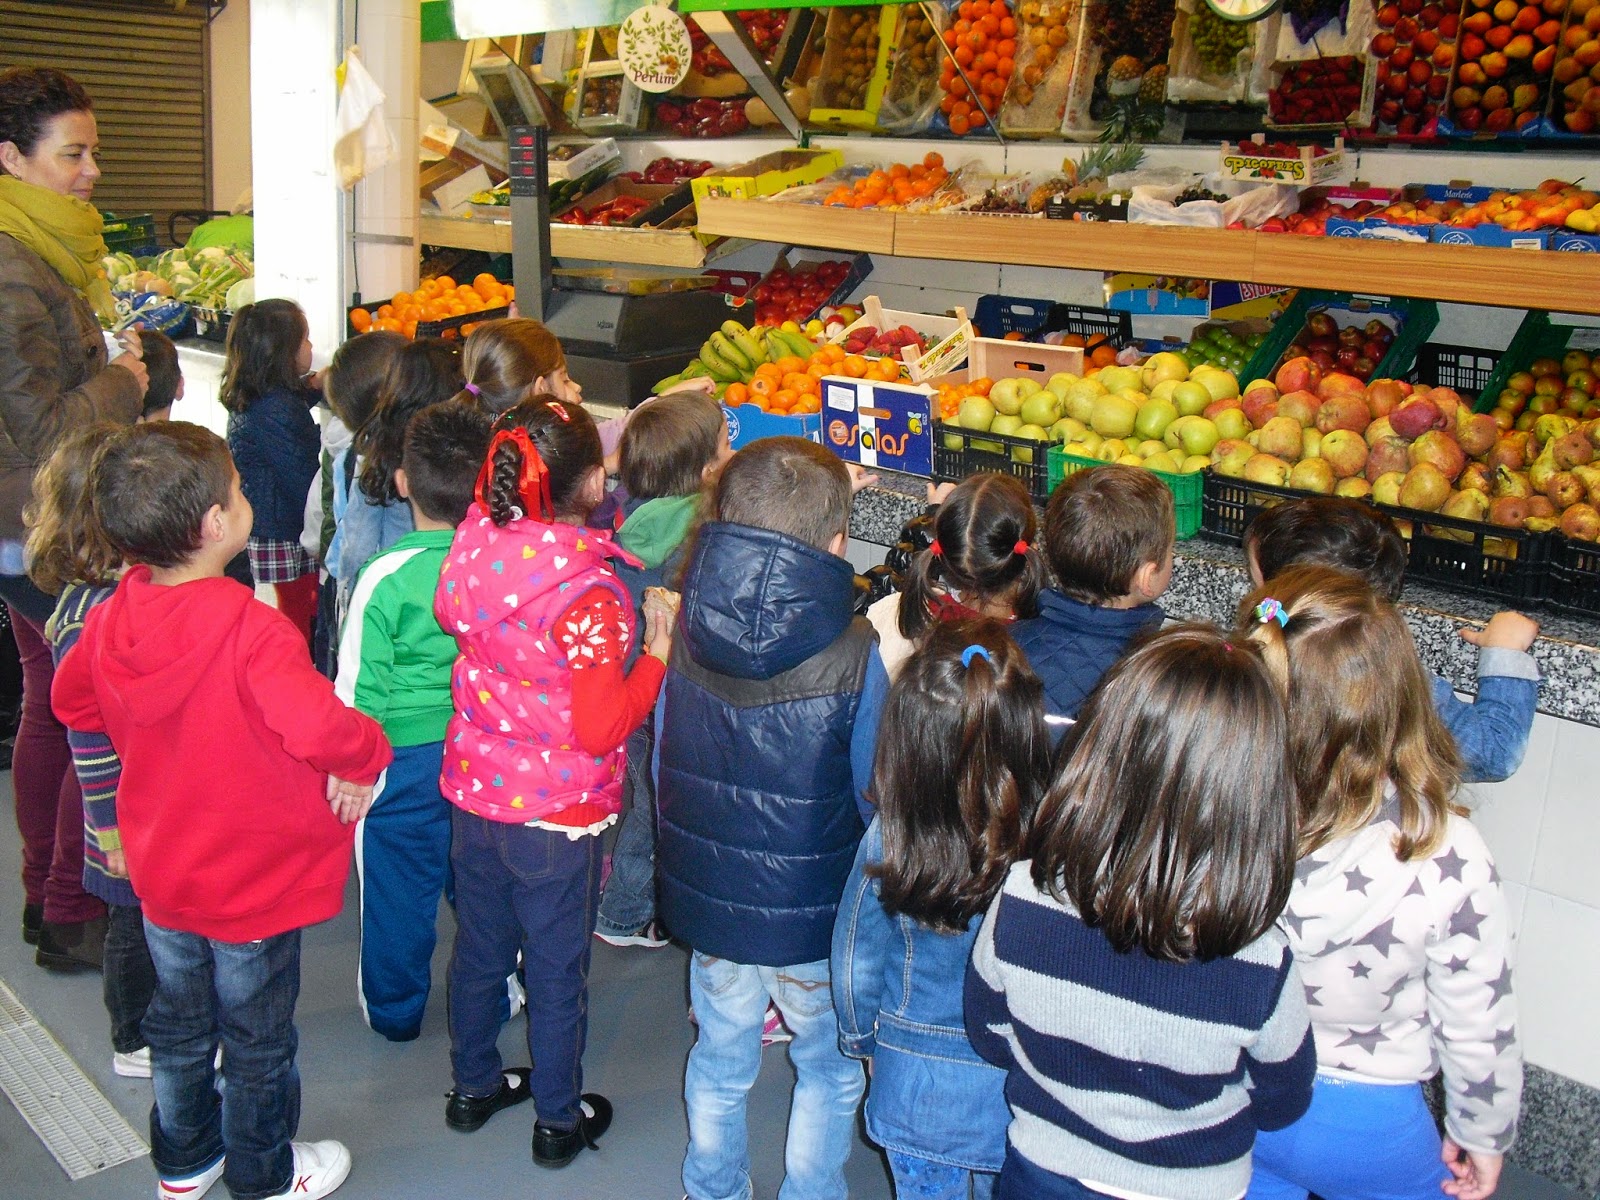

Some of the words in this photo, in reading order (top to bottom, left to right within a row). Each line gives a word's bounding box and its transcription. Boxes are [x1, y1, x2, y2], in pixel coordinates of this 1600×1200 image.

[633, 70, 677, 84] Perlim
[1224, 156, 1304, 180] PICOFRES
[293, 1174, 312, 1193] K
